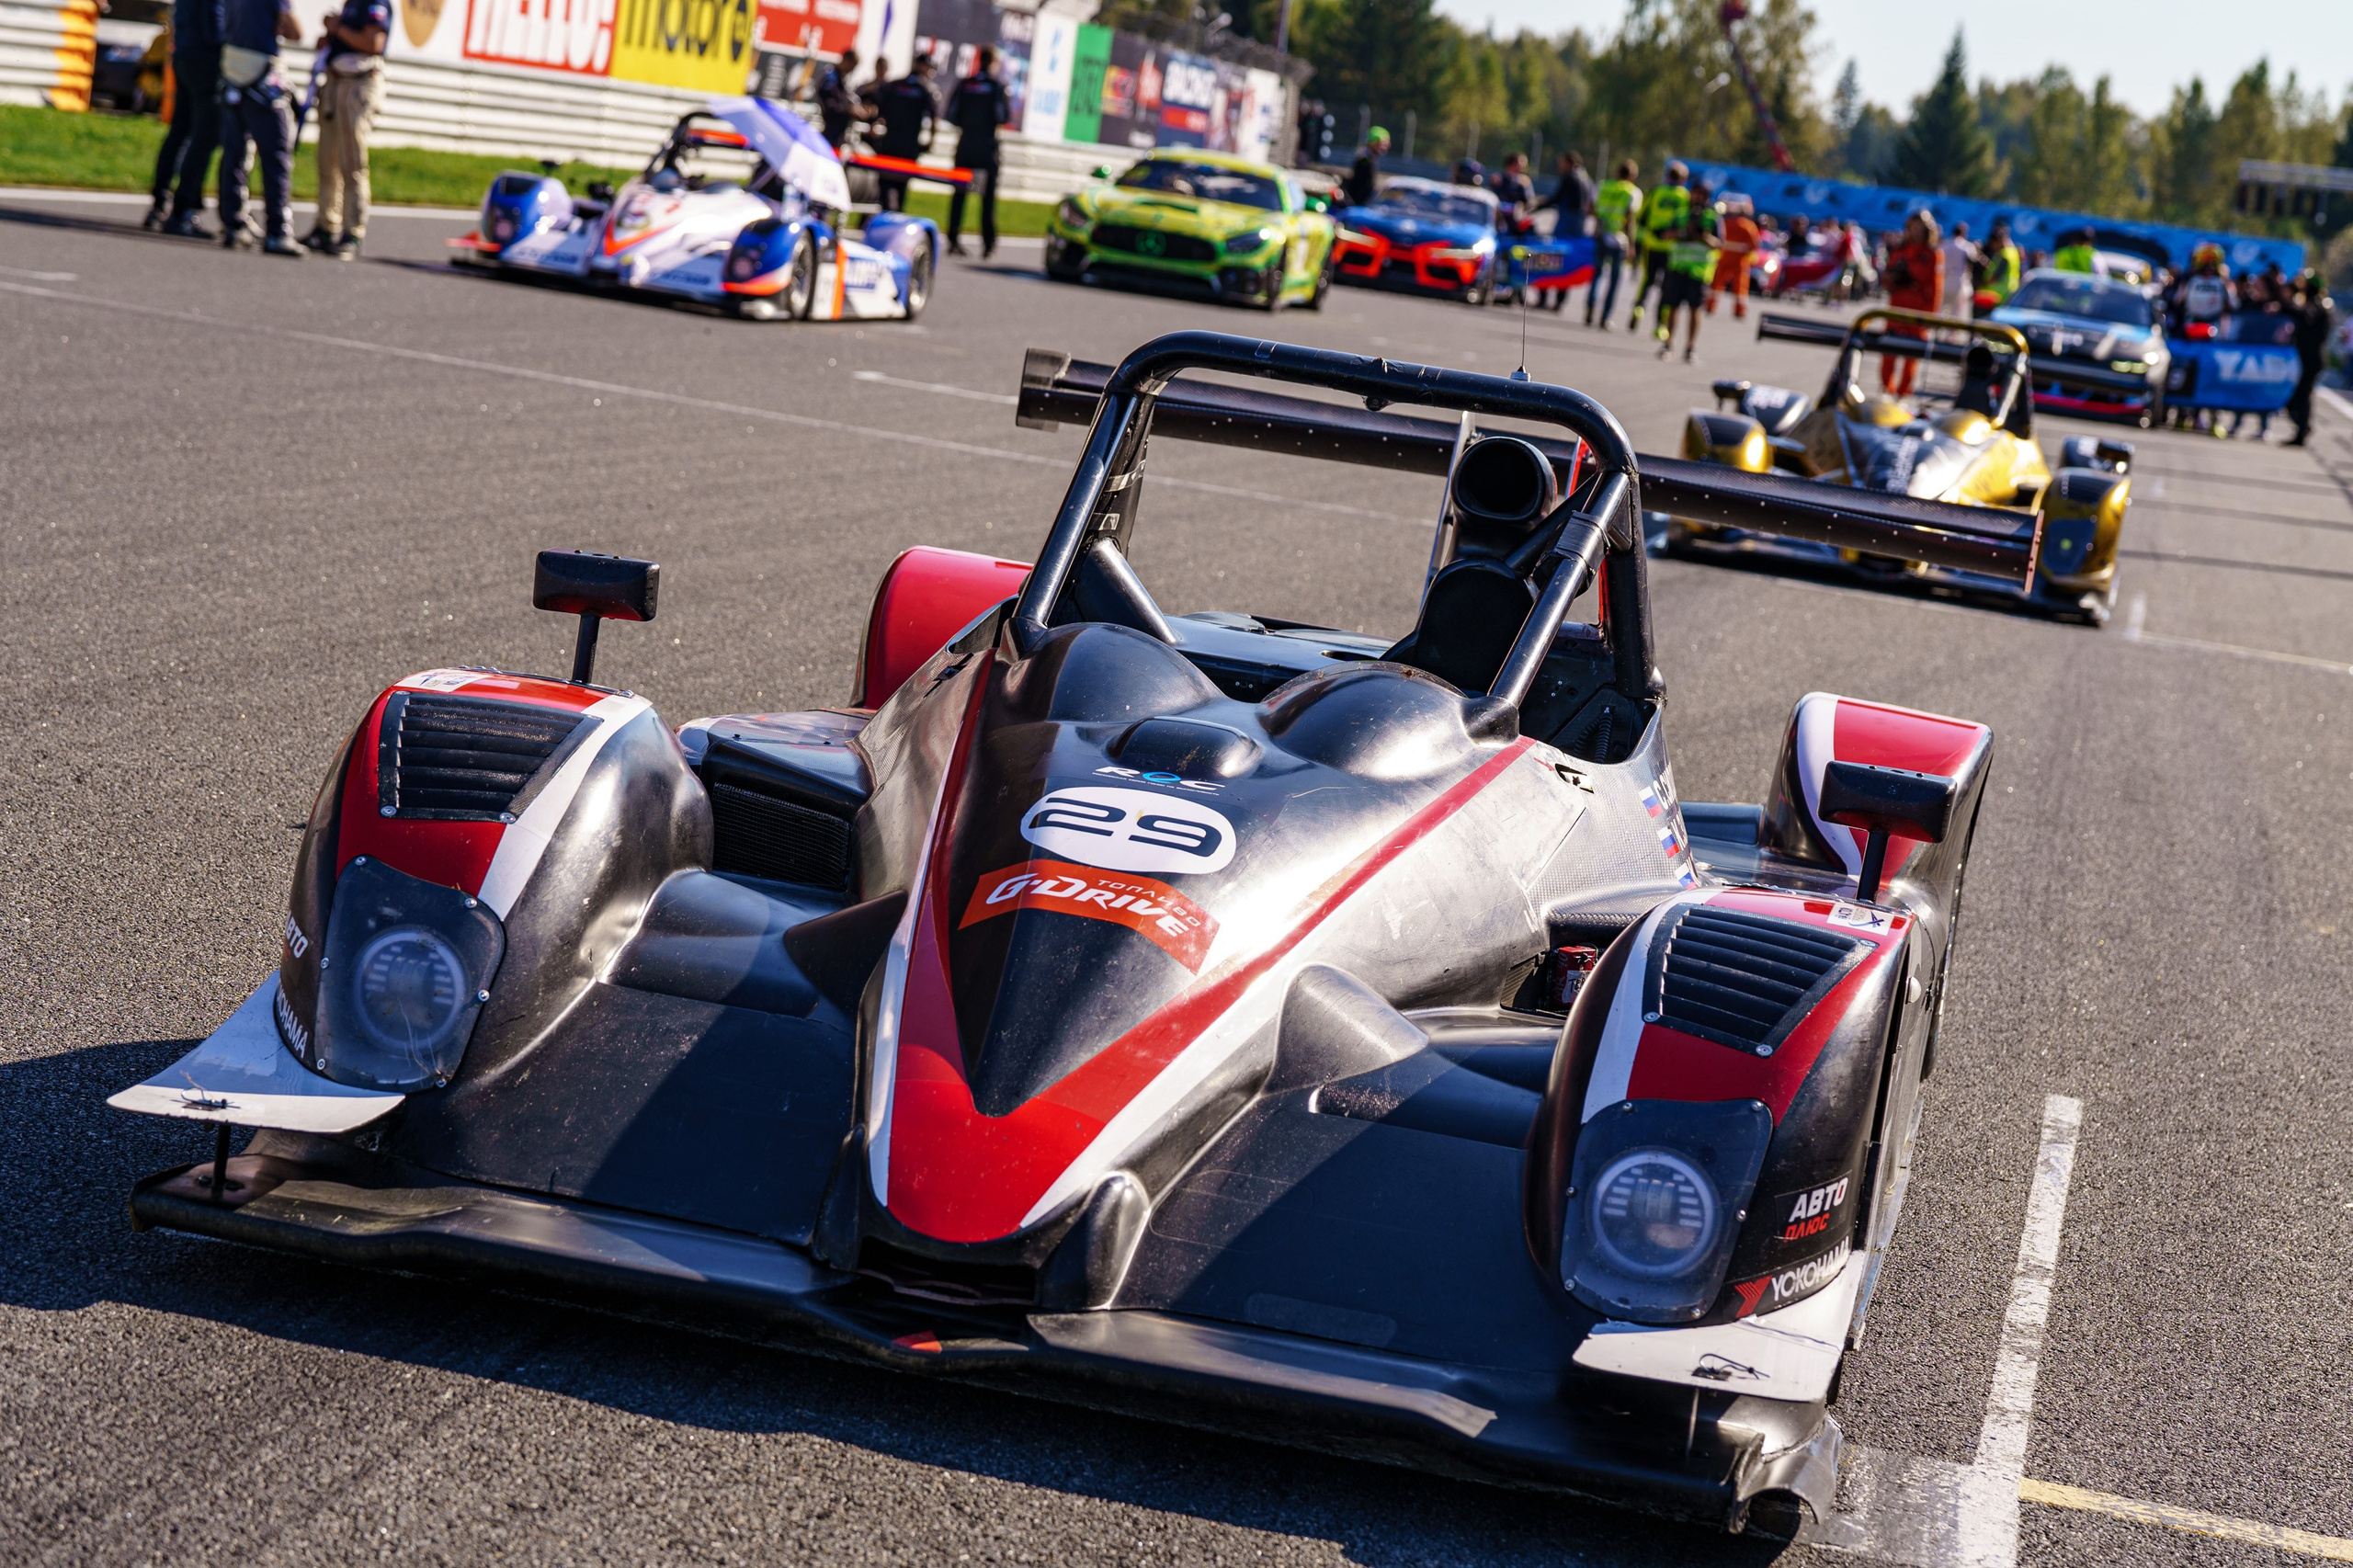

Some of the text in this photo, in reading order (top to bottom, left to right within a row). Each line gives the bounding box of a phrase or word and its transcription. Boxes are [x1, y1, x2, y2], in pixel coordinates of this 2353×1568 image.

[1028, 797, 1222, 858] 29
[1098, 879, 1201, 927] ТОПЛИВО
[1789, 1177, 1848, 1222] АВТО
[1784, 1213, 1829, 1243] ПЛЮС
